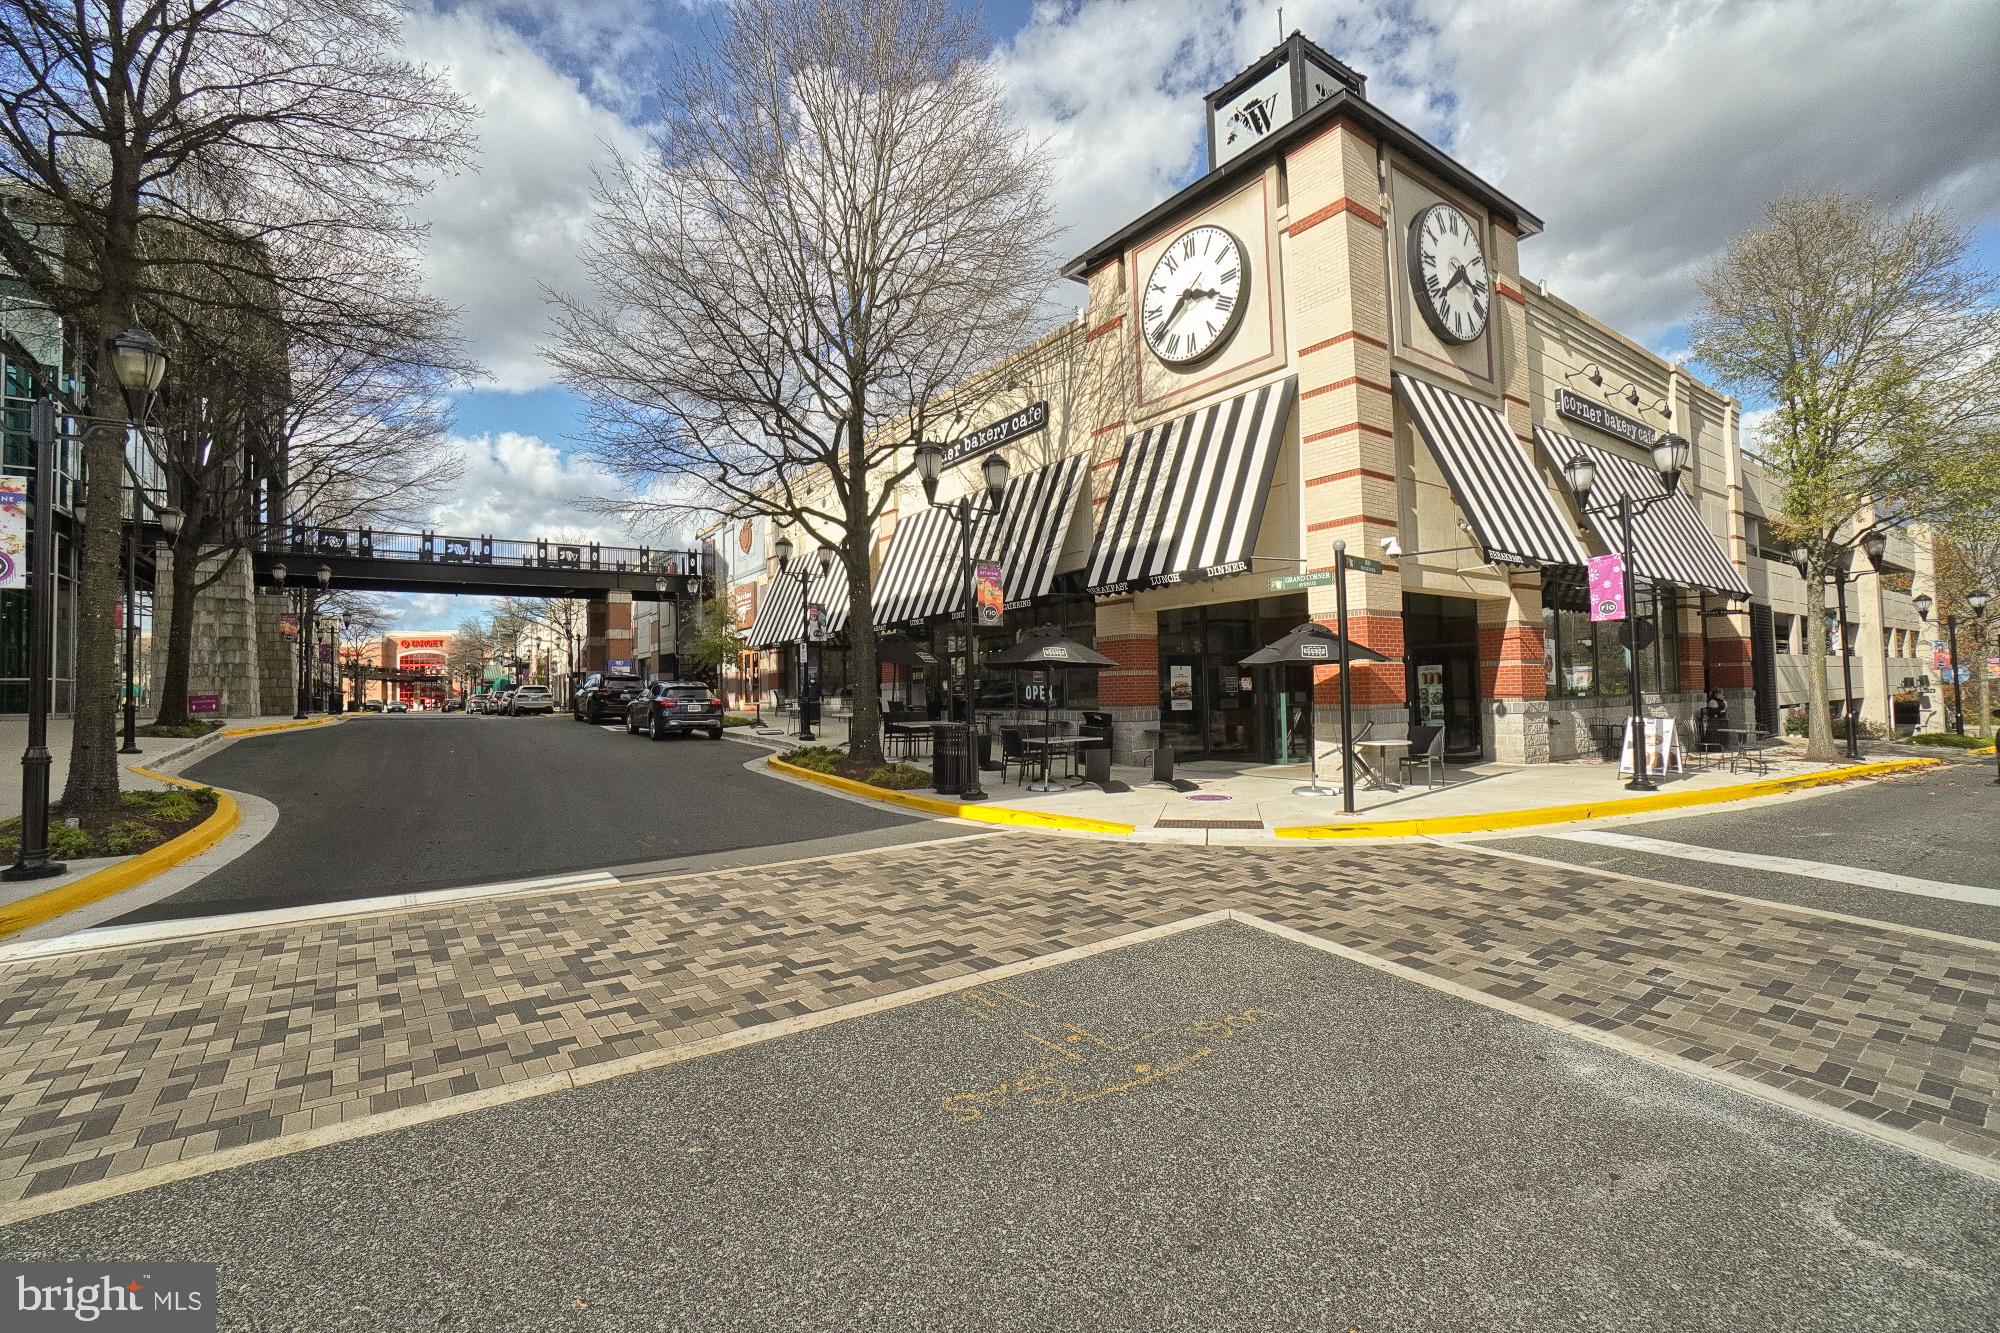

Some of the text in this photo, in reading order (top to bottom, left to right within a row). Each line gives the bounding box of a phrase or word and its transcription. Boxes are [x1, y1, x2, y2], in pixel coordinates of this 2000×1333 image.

[1563, 395, 1657, 445] corner bakery cafe
[964, 422, 1009, 452] bakery
[1012, 406, 1042, 431] cafe
[1086, 561, 1248, 596] BREAKFAST LUNCH DINNER
[1284, 571, 1331, 584] GRAND CORNER
[1002, 599, 1032, 611] CATERING
[1600, 603, 1616, 611] rio
[412, 639, 446, 648] TARGET
